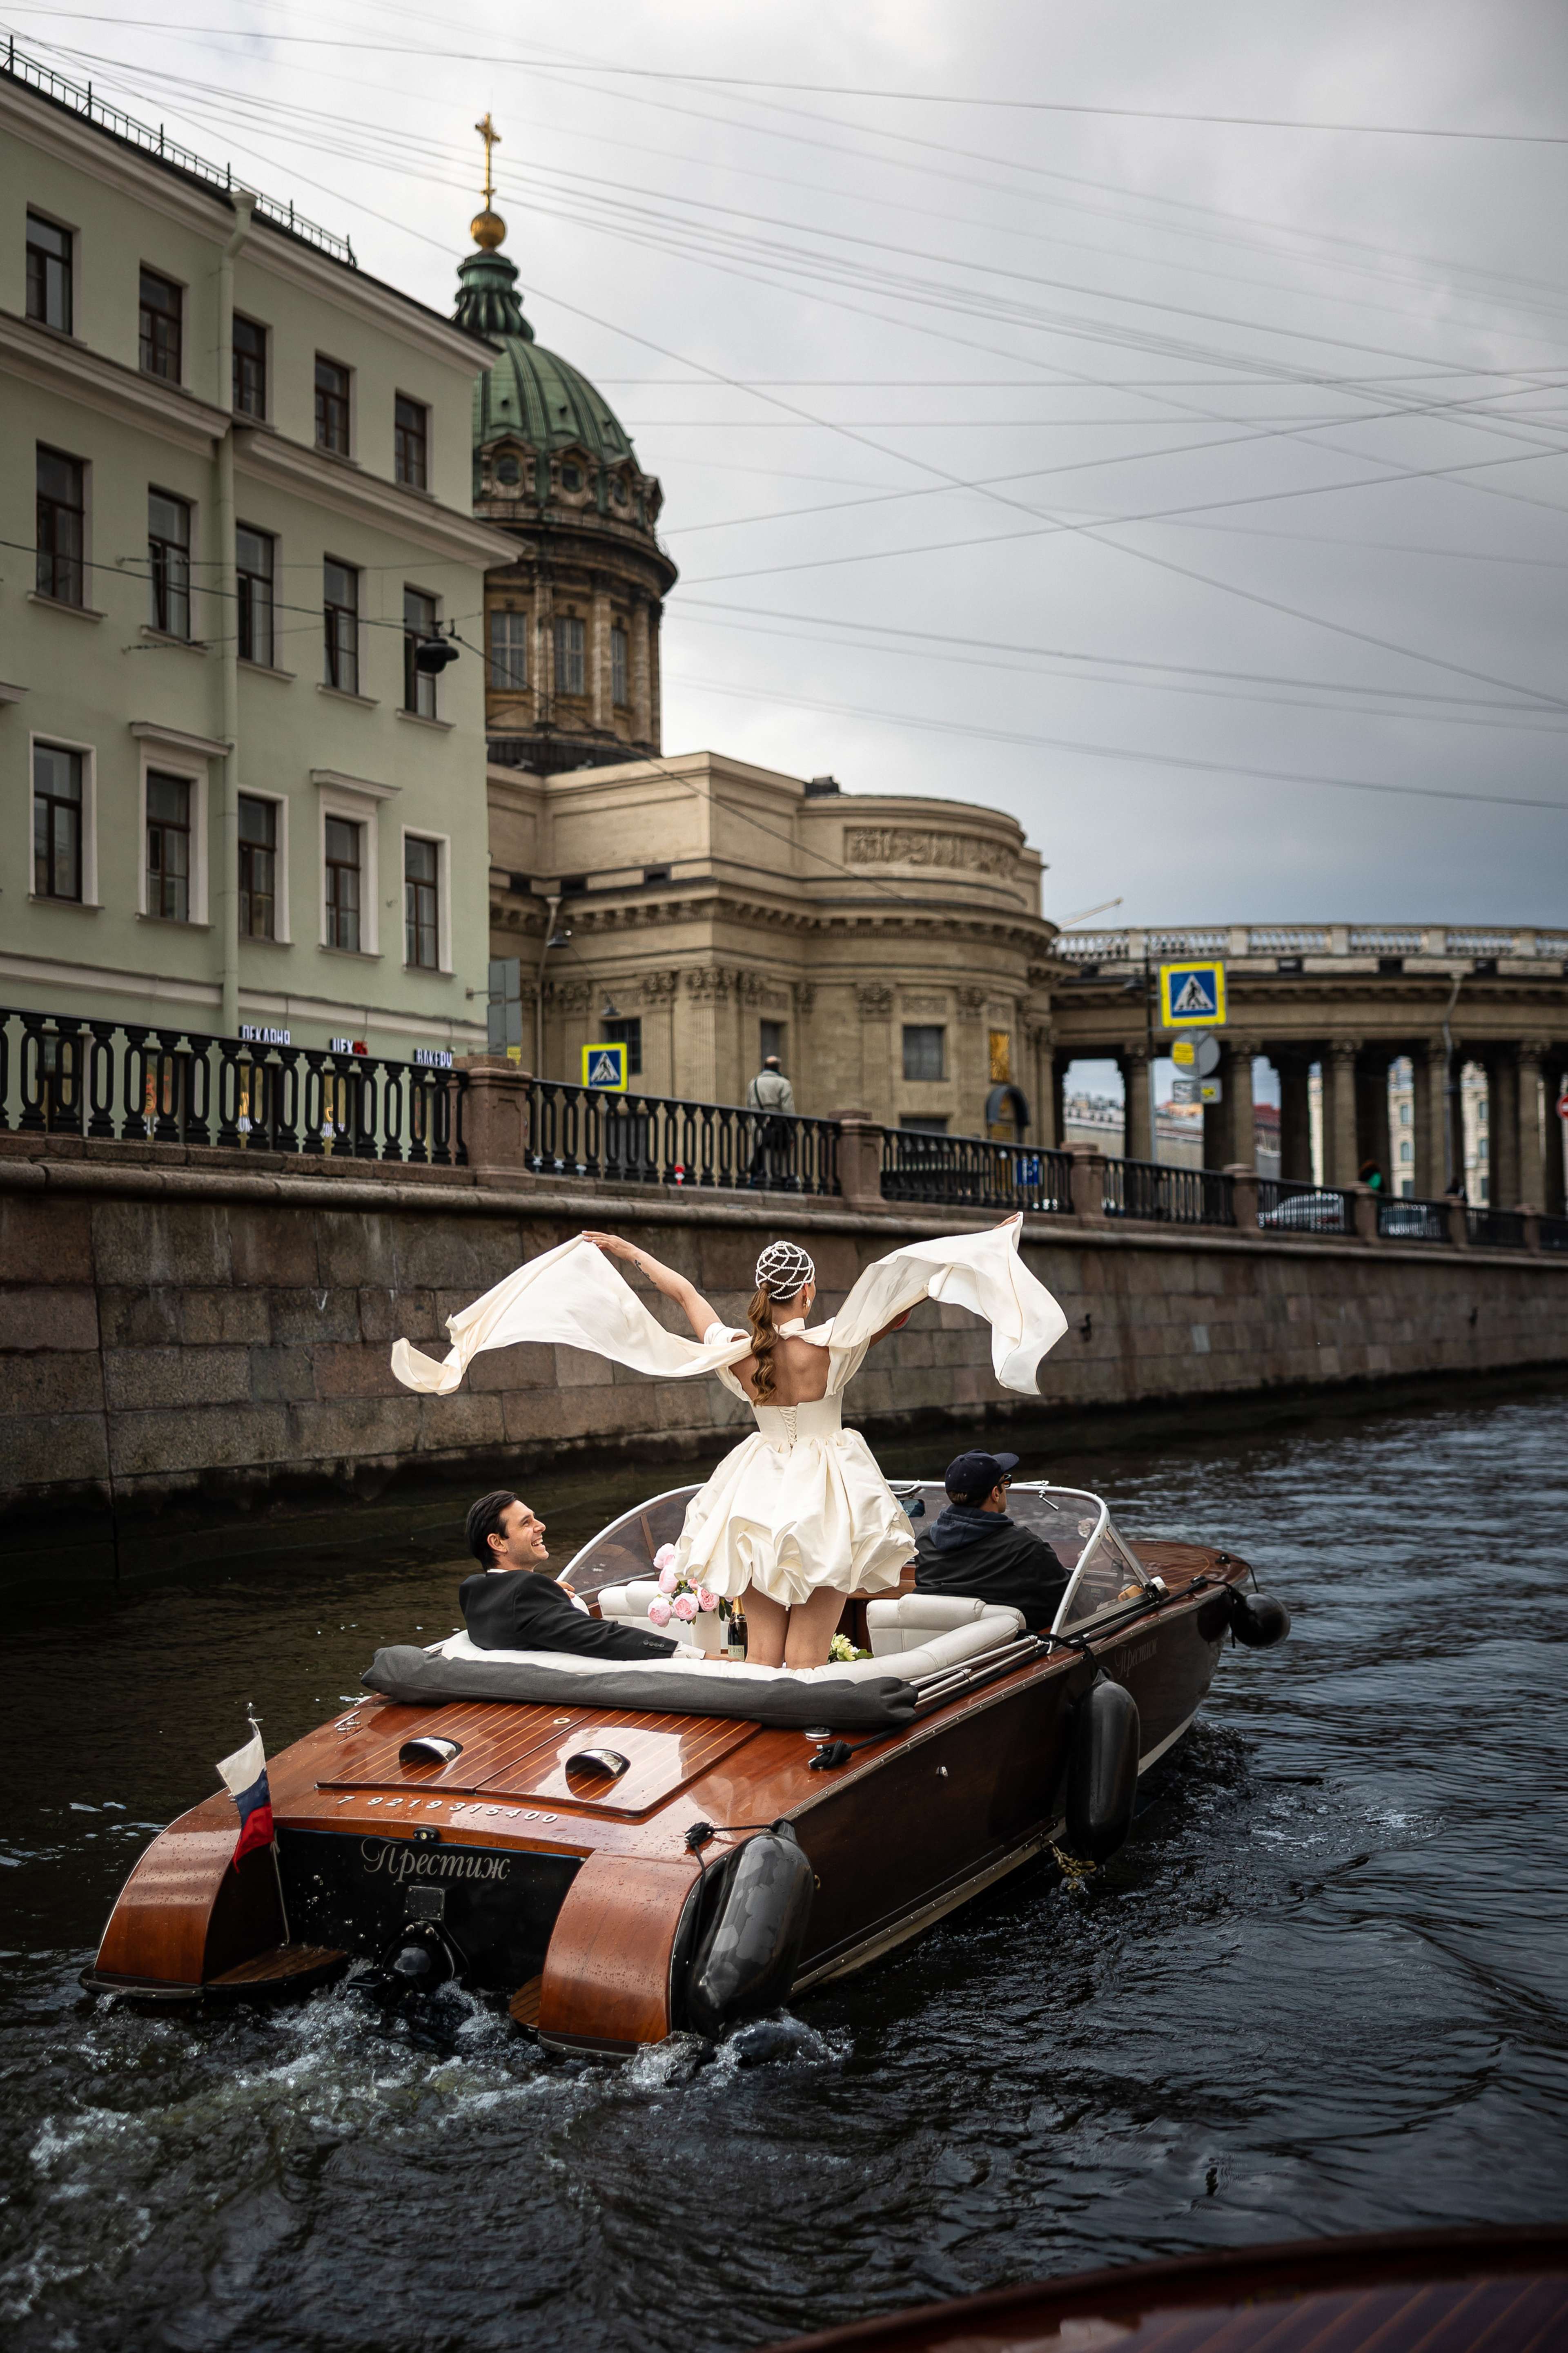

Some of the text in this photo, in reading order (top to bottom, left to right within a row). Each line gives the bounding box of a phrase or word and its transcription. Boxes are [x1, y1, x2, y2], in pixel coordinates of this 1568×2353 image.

[1114, 1637, 1159, 1679] Престиж
[337, 1796, 356, 1804] 7
[361, 1836, 510, 1882] Престиж
